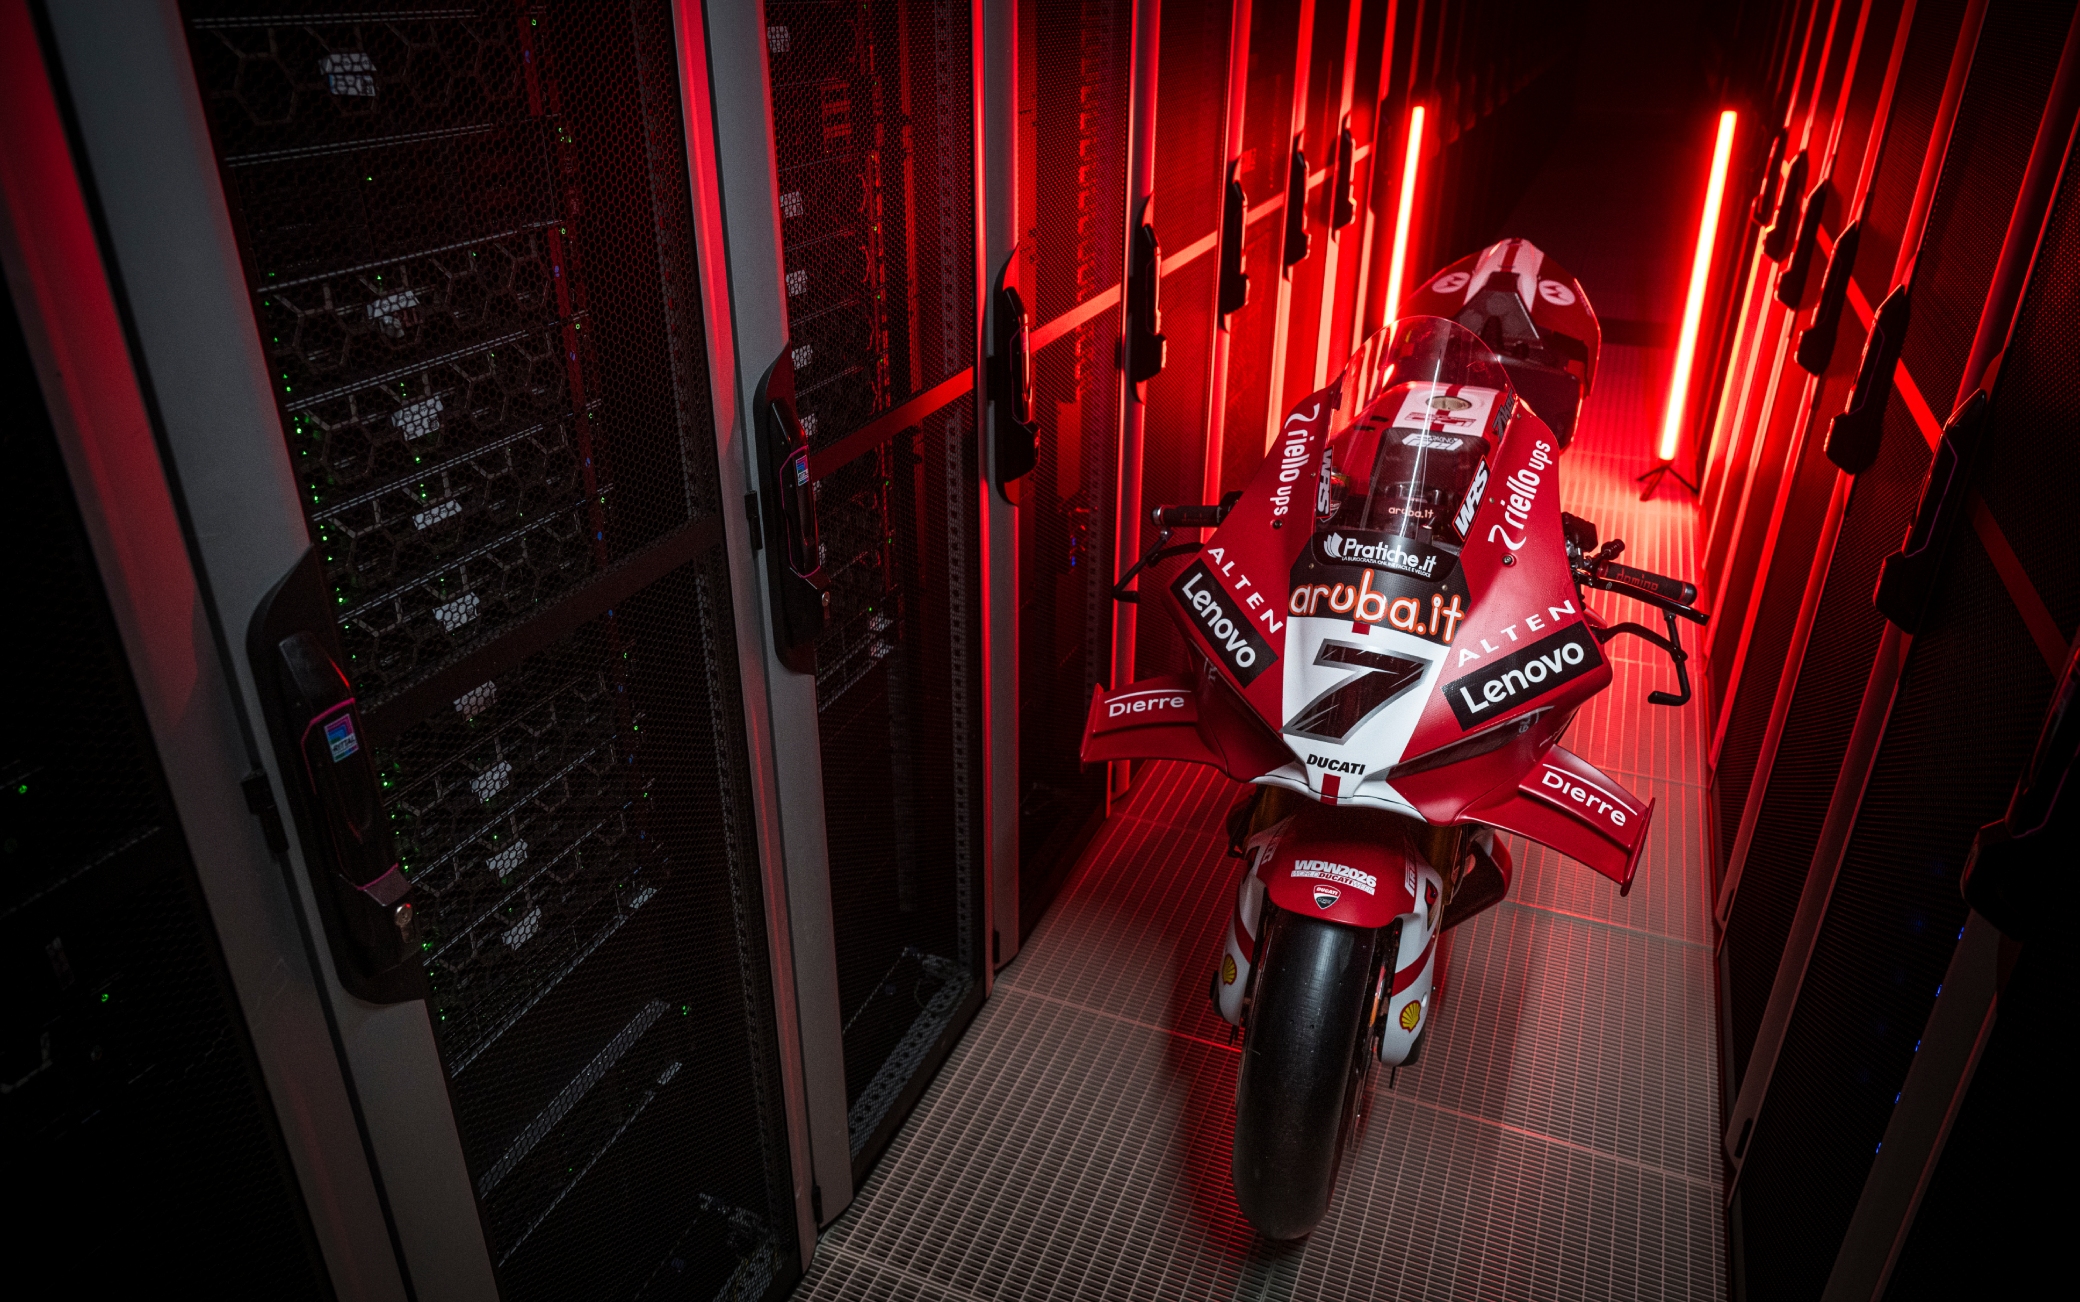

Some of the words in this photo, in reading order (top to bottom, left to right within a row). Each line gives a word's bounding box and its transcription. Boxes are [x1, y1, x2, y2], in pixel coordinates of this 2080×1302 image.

[1279, 429, 1315, 482] riello
[1317, 448, 1333, 515] WRS
[1500, 468, 1541, 530] riello
[1528, 440, 1553, 471] ups
[1270, 485, 1292, 516] ups
[1454, 460, 1488, 537] WRS
[1343, 538, 1437, 573] Pratiche.it
[1615, 568, 1659, 591] domino
[1181, 572, 1256, 668] Lenovo
[1207, 547, 1284, 634] ALTEN
[1288, 568, 1465, 644] aruba.it
[1458, 599, 1576, 668] ALTEN
[1108, 696, 1185, 717] Dierre
[1279, 637, 1434, 746] 7
[1459, 642, 1584, 714] Lenovo
[1306, 753, 1366, 775] DUCATI
[1541, 770, 1626, 827] Dierre
[1294, 859, 1377, 888] WDW2026
[1316, 886, 1338, 896] DUCATI
